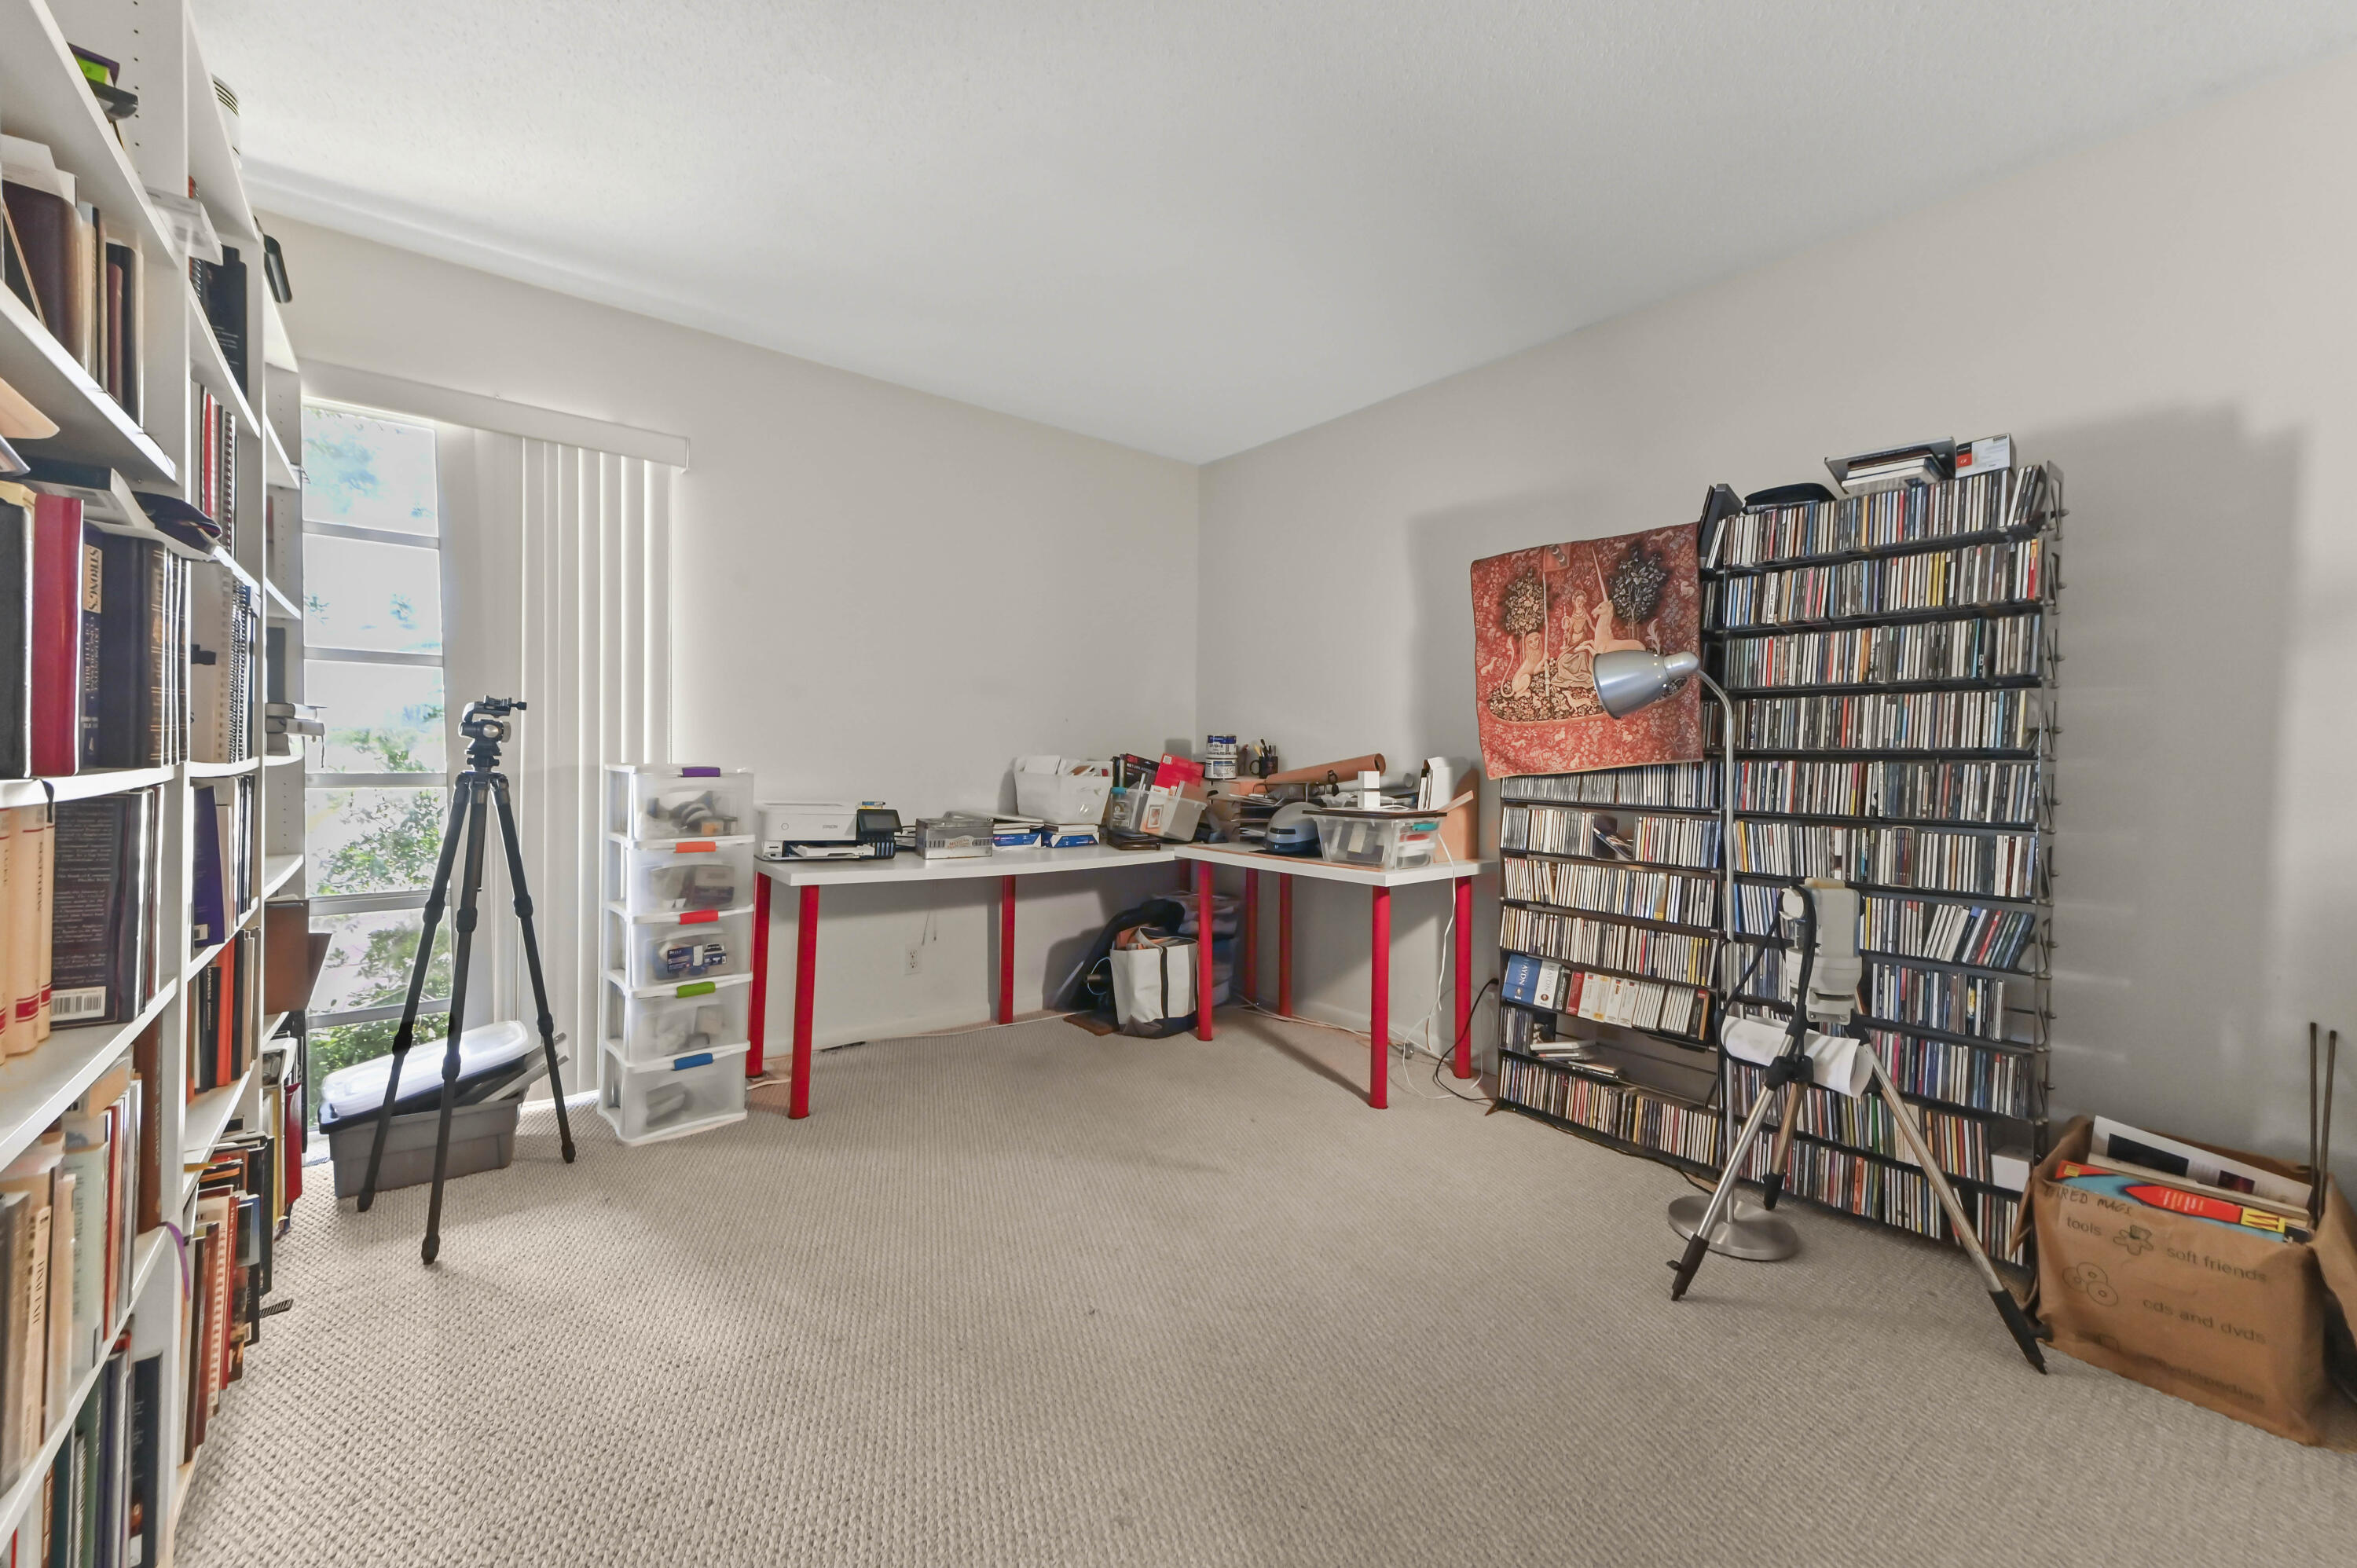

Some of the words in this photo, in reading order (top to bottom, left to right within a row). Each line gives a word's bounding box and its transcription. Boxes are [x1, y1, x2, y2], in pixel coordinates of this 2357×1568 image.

[88, 548, 99, 610] STRONG'S
[2067, 1216, 2102, 1236] tools
[2166, 1247, 2198, 1264] soft
[2203, 1255, 2268, 1282] friends
[2143, 1299, 2174, 1316] cds
[2179, 1310, 2213, 1328] and
[2220, 1323, 2266, 1344] dvds
